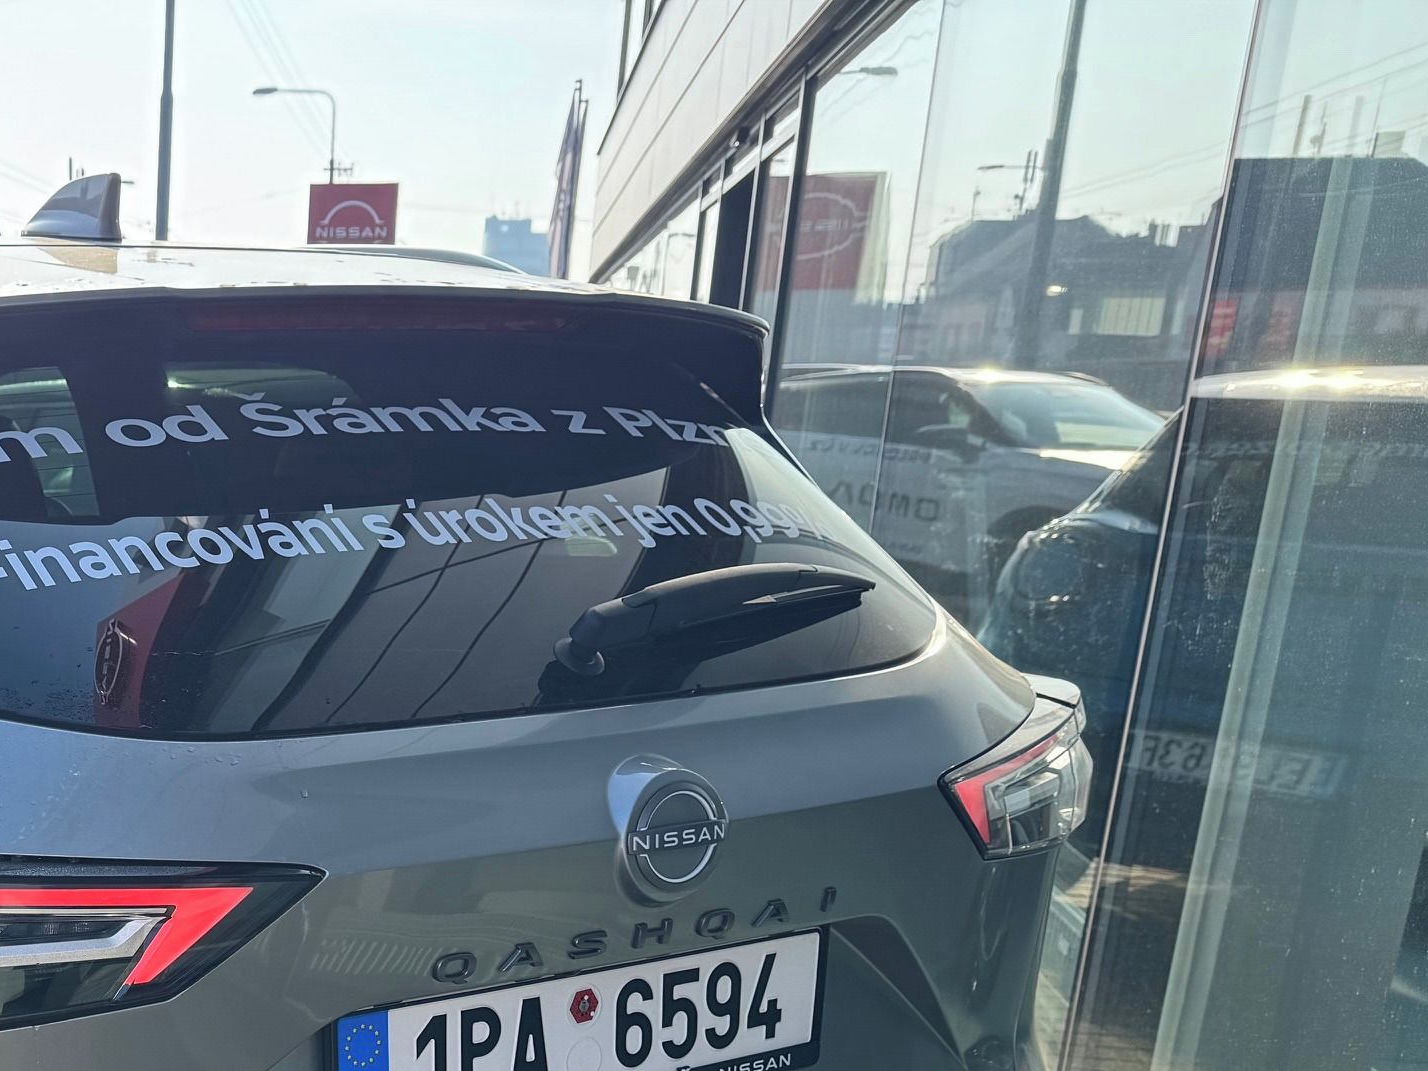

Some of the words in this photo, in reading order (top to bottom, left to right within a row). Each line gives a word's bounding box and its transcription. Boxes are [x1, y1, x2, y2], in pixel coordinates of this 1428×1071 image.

[315, 226, 387, 239] NISSAN
[105, 405, 228, 447] od
[239, 392, 546, 438] Šrámka
[552, 408, 606, 436] z
[362, 513, 406, 549] s
[604, 494, 708, 549] jen
[632, 822, 727, 852] NISSAN
[431, 886, 837, 985] QASHQAI
[613, 953, 782, 1069] 6594
